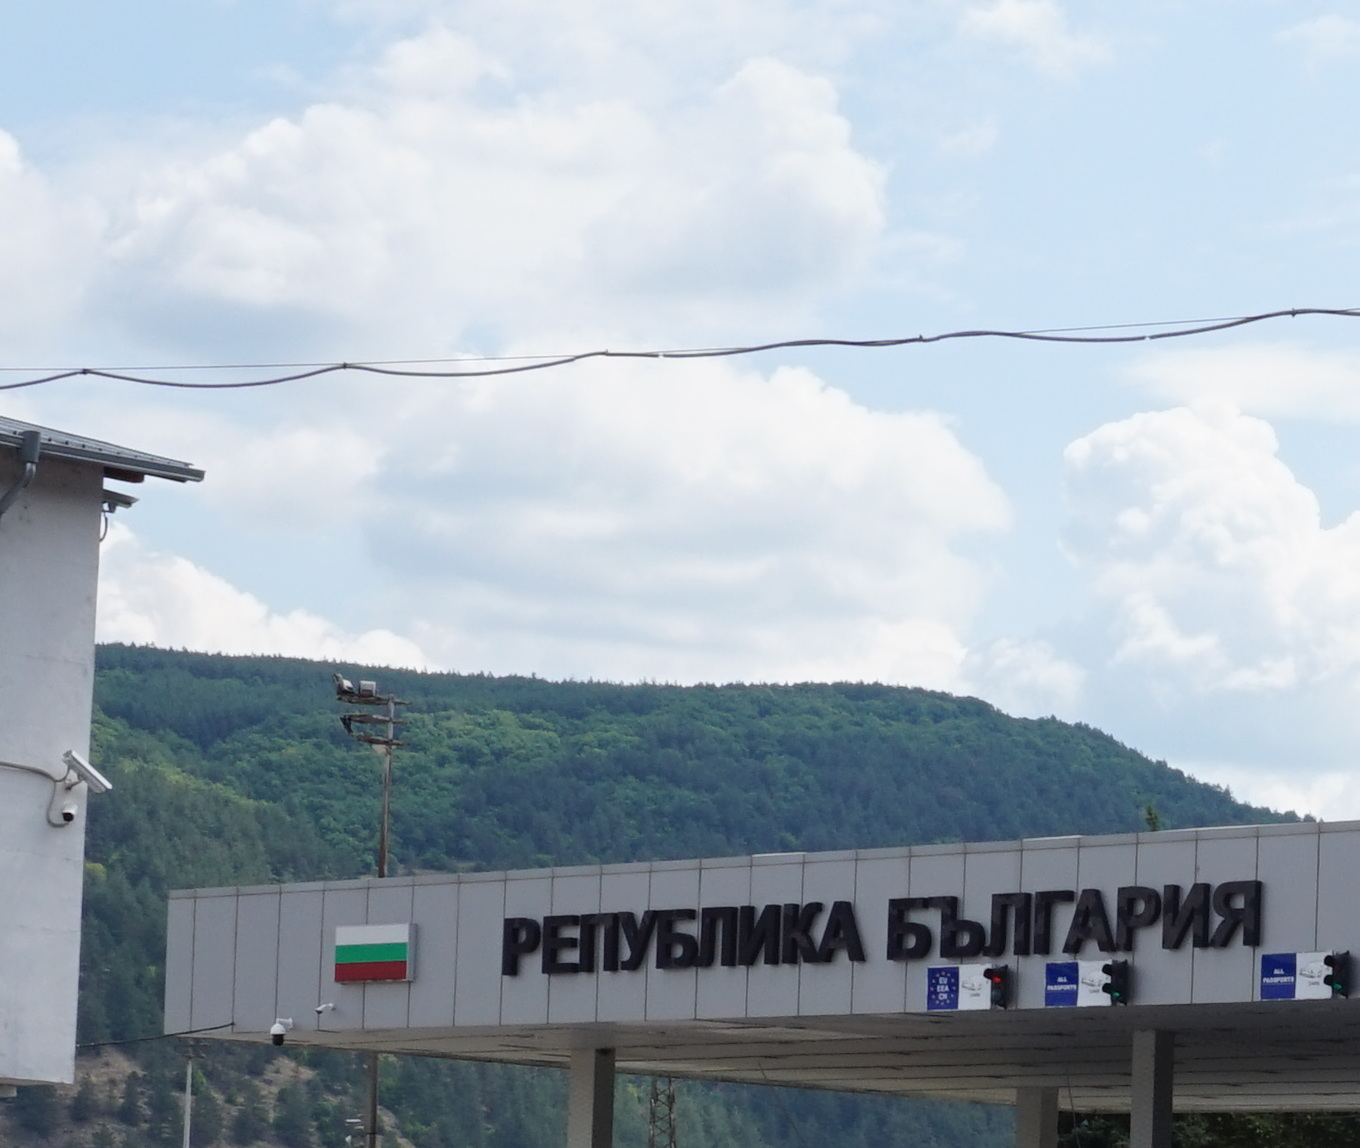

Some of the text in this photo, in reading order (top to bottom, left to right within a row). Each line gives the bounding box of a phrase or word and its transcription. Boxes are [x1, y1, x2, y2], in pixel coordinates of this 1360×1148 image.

[502, 880, 1262, 976] РЕПУБЛИКА БЪЛГАРИЯ
[939, 976, 948, 984] EU
